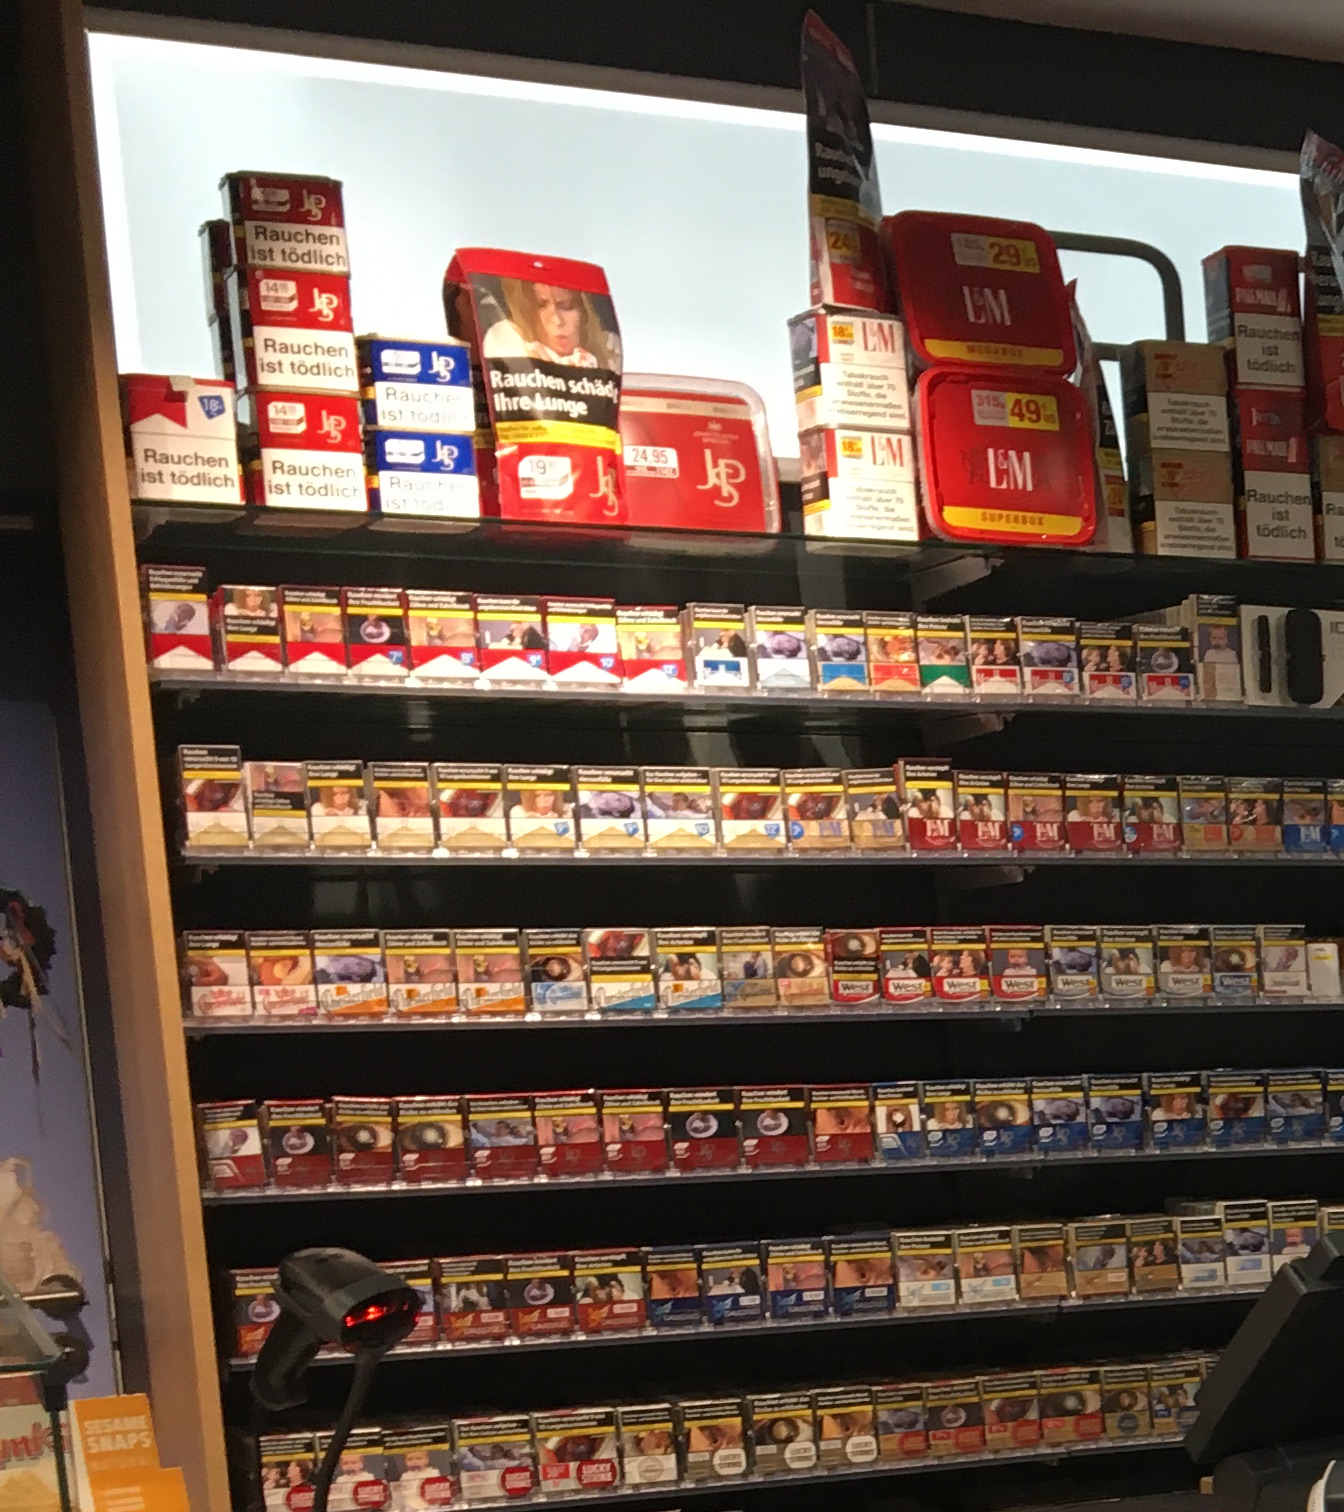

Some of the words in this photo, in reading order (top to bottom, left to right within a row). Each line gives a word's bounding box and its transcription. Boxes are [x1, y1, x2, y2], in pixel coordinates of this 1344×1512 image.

[254, 225, 341, 246] Rauchen
[251, 244, 276, 262] ist
[282, 247, 346, 267] tödlich
[1238, 324, 1300, 340] Rauchen
[264, 339, 349, 357] Rauchen
[1261, 344, 1279, 356] ist
[259, 354, 284, 374] ist
[289, 356, 355, 379] tödlich
[1247, 359, 1296, 374] tödlich
[494, 392, 531, 412] Ihre
[531, 393, 588, 417] Lunge
[143, 449, 229, 468] Rauchen
[632, 448, 668, 466] 24,95
[140, 465, 163, 483] ist
[170, 467, 235, 488] tödlich
[272, 460, 356, 479] Rauchen
[987, 447, 1033, 491] L&M
[268, 481, 291, 495] ist
[296, 481, 361, 497] tödlich
[1247, 489, 1312, 506] Rauchen
[1272, 508, 1290, 522] ist
[1256, 524, 1307, 540] tödlich
[84, 1415, 147, 1429] SESAME
[87, 1432, 152, 1453] SNAPS
